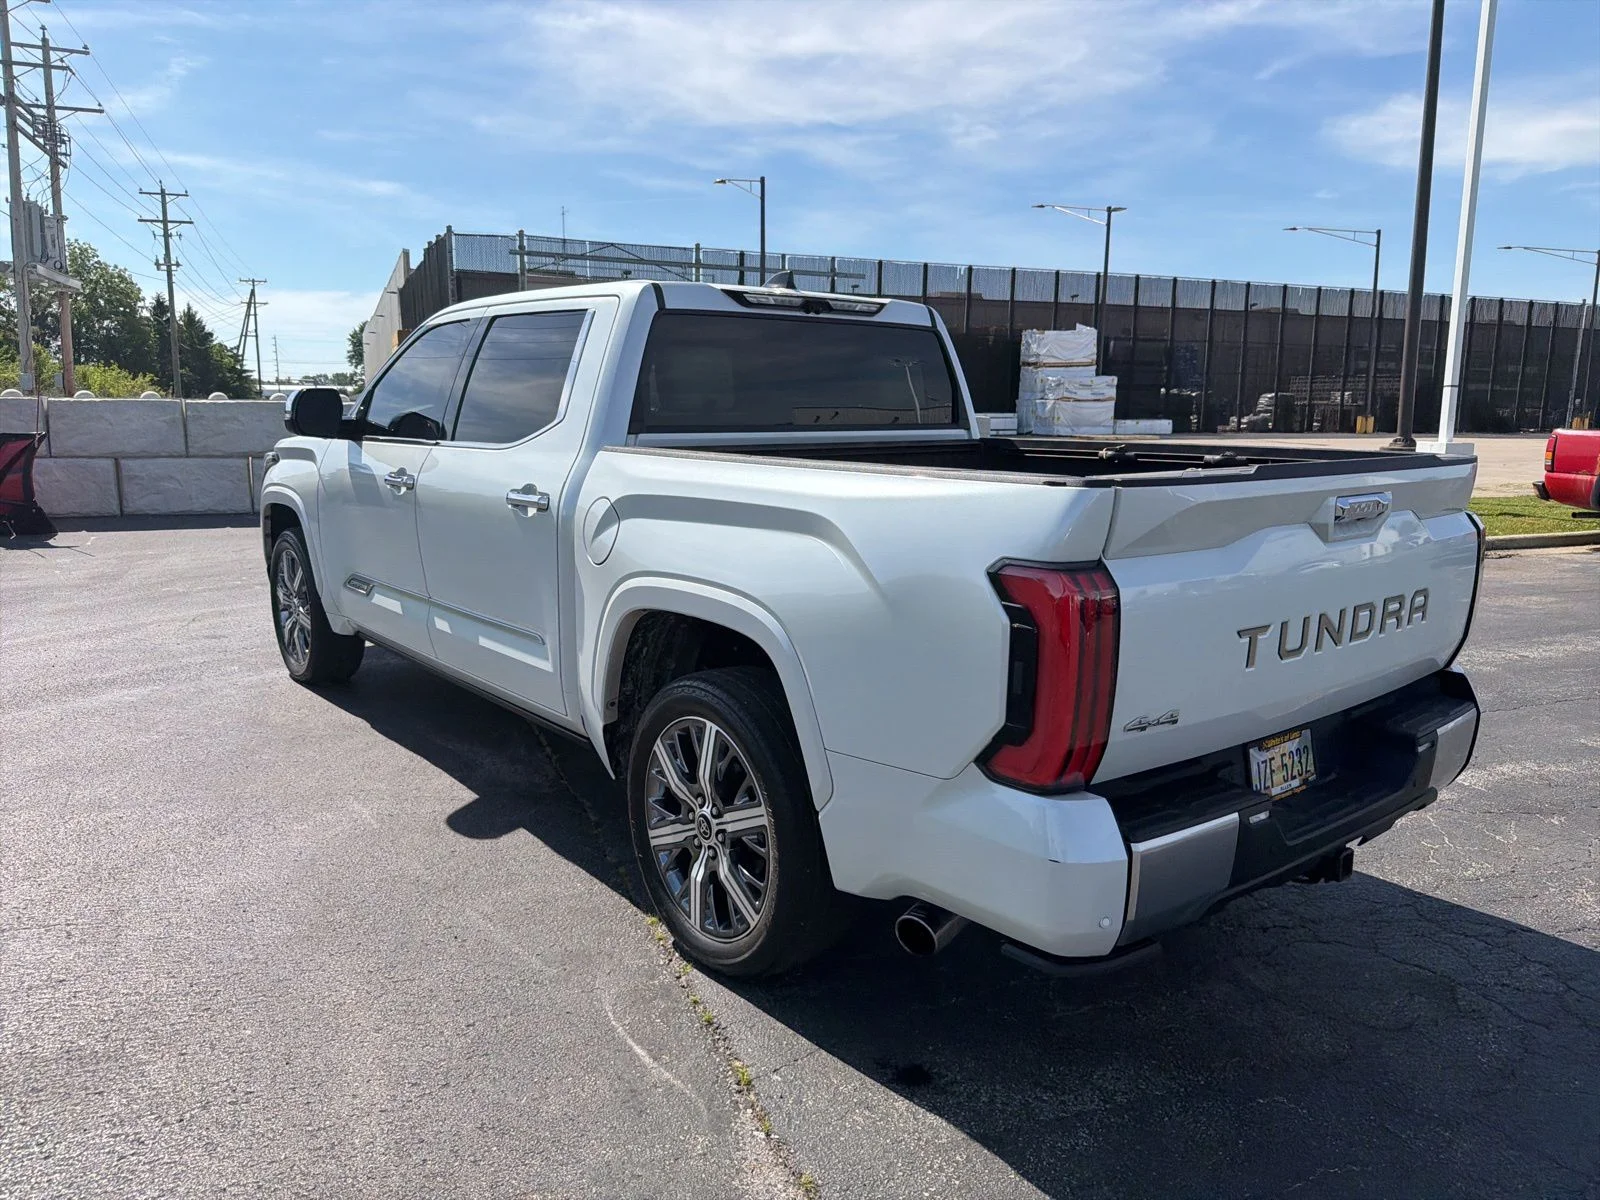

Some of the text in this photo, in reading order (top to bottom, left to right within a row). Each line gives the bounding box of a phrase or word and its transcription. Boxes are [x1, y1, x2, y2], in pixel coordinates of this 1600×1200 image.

[1237, 587, 1430, 671] TUNDRA
[1254, 745, 1312, 792] JZF 5232
